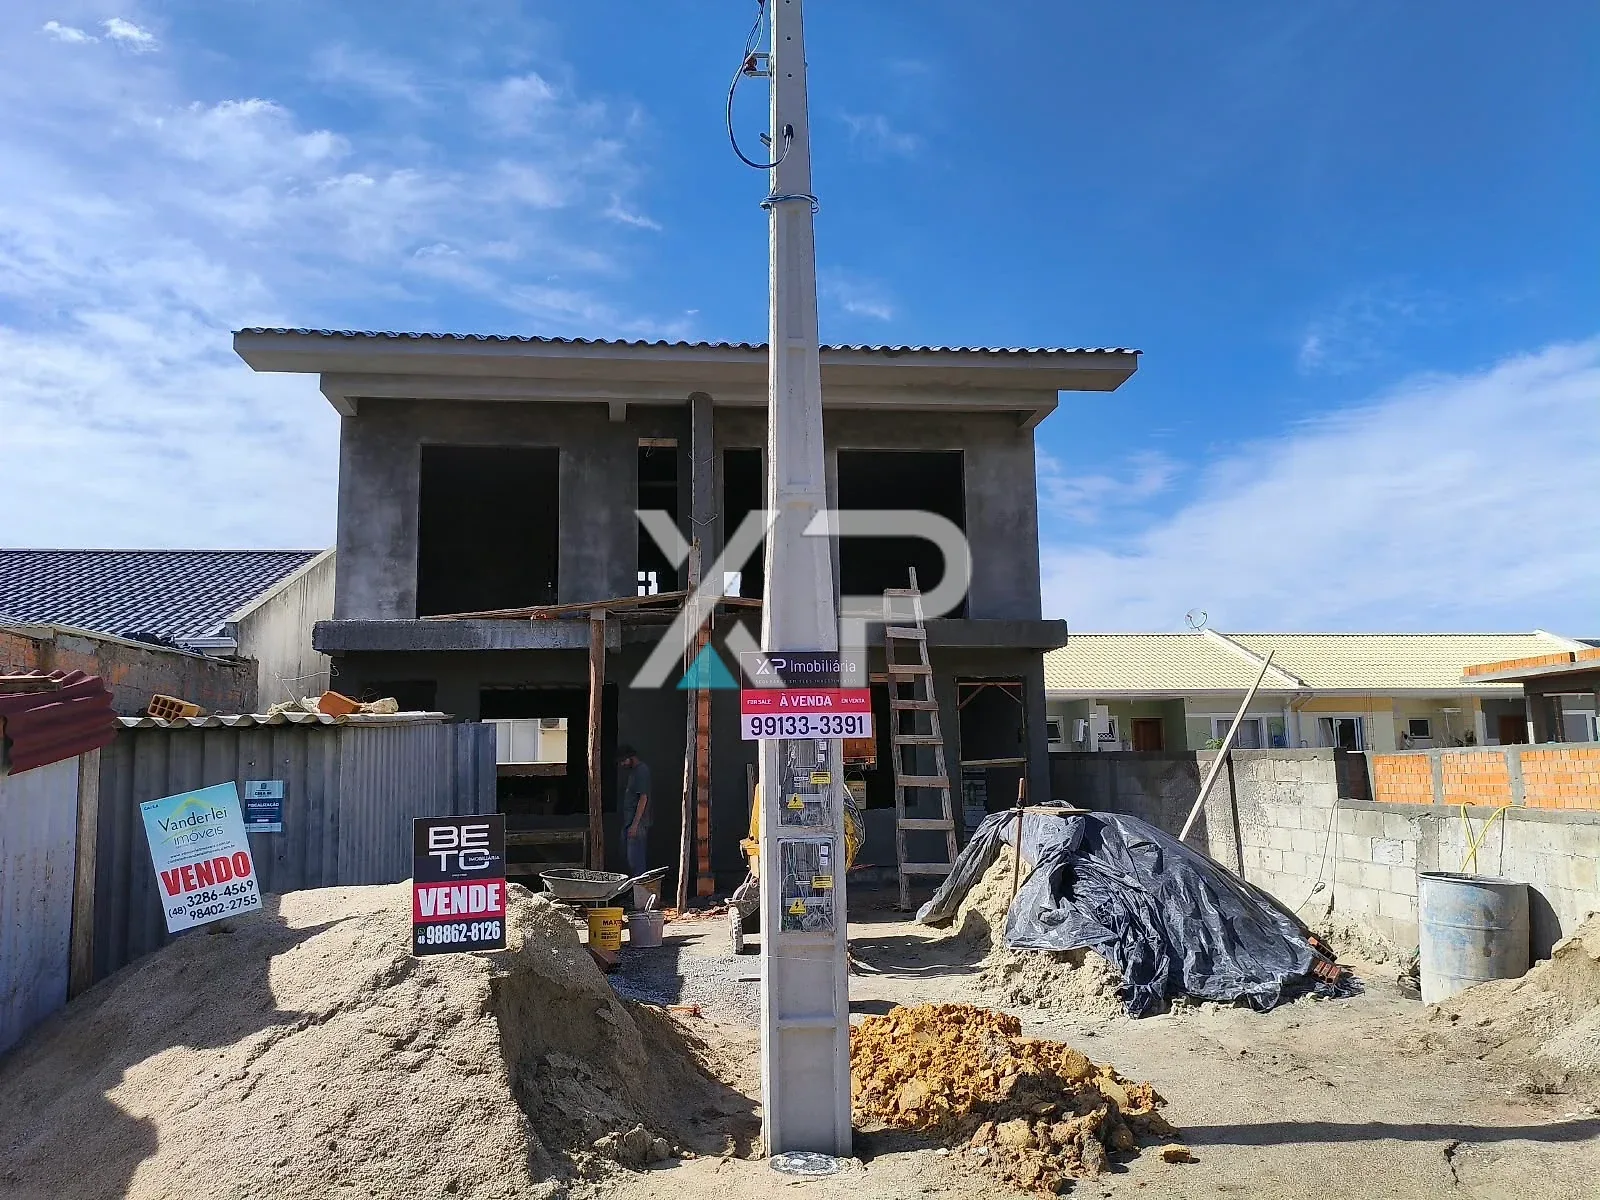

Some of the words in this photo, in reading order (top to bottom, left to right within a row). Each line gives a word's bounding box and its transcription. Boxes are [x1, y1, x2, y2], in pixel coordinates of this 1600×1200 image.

[755, 658, 787, 675] XP
[790, 659, 857, 673] Imobiliária
[779, 693, 789, 707] À
[791, 695, 833, 707] VENDA
[750, 715, 864, 736] 99133-3391
[158, 807, 229, 833] Vanderlei
[173, 825, 224, 845] imóveis
[160, 851, 252, 896] VENDO
[186, 880, 254, 908] 3286-4569
[417, 883, 501, 917] VENDE
[168, 905, 187, 918] (48)
[189, 894, 258, 921] 98402-2755
[426, 921, 501, 945] 98862-8126
